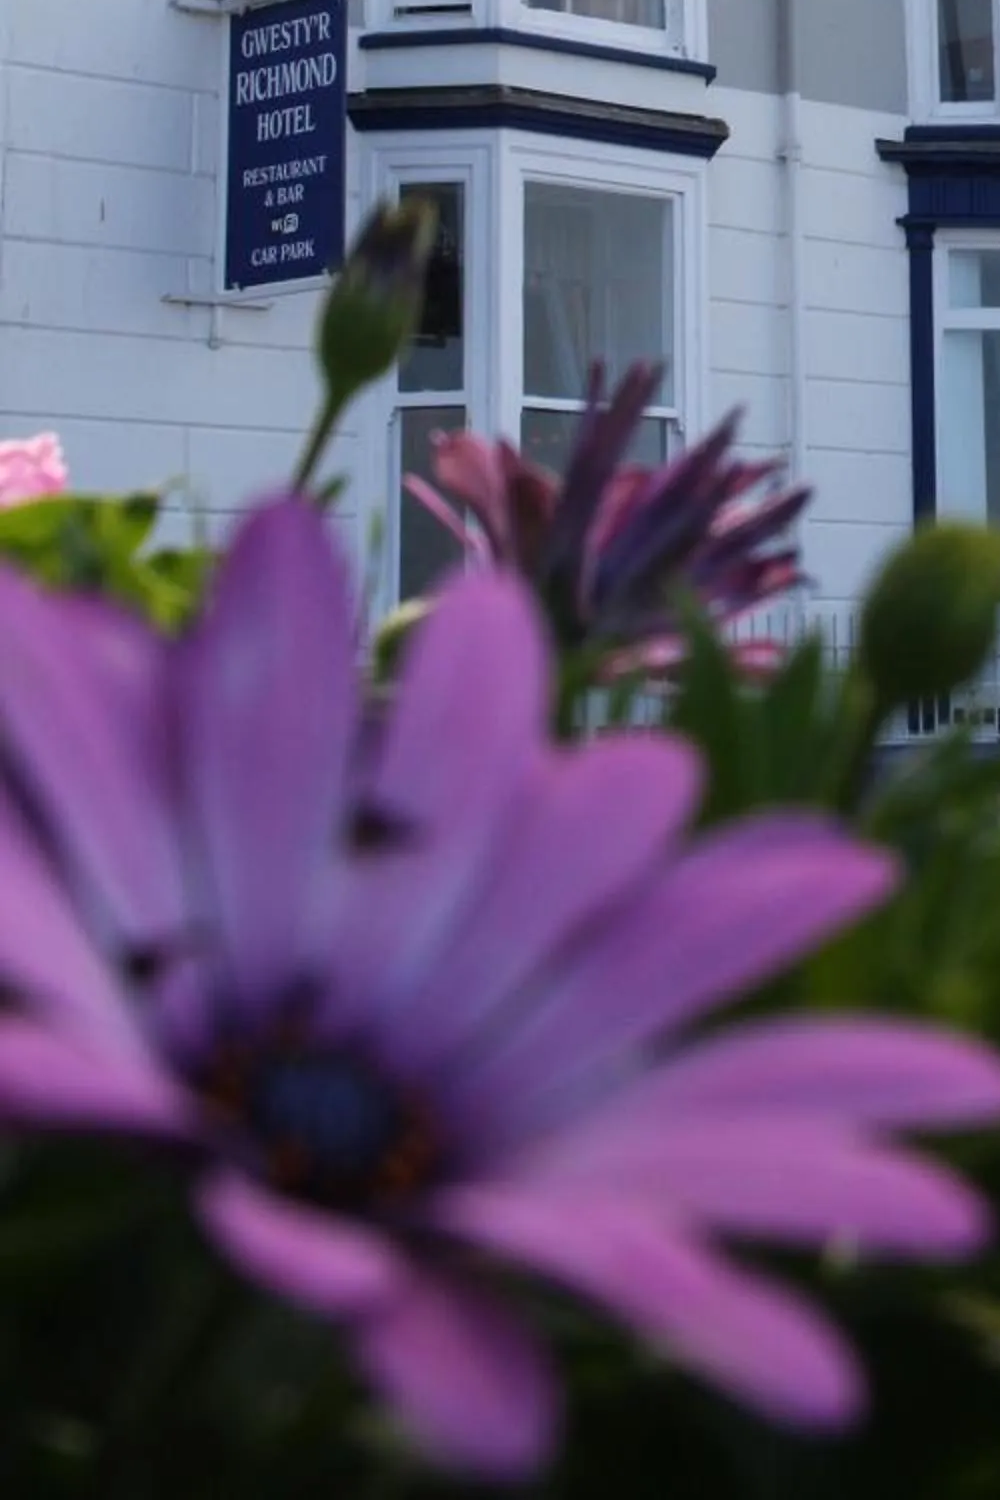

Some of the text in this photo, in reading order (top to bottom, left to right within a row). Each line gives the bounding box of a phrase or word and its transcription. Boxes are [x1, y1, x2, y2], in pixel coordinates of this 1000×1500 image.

[241, 11, 331, 59] GWESTY'R
[236, 52, 338, 105] RICHMOND
[256, 104, 316, 142] HOTEL
[243, 155, 328, 188] RESTAURANT
[277, 183, 305, 206] BAR
[250, 239, 315, 268] CAR PARK
